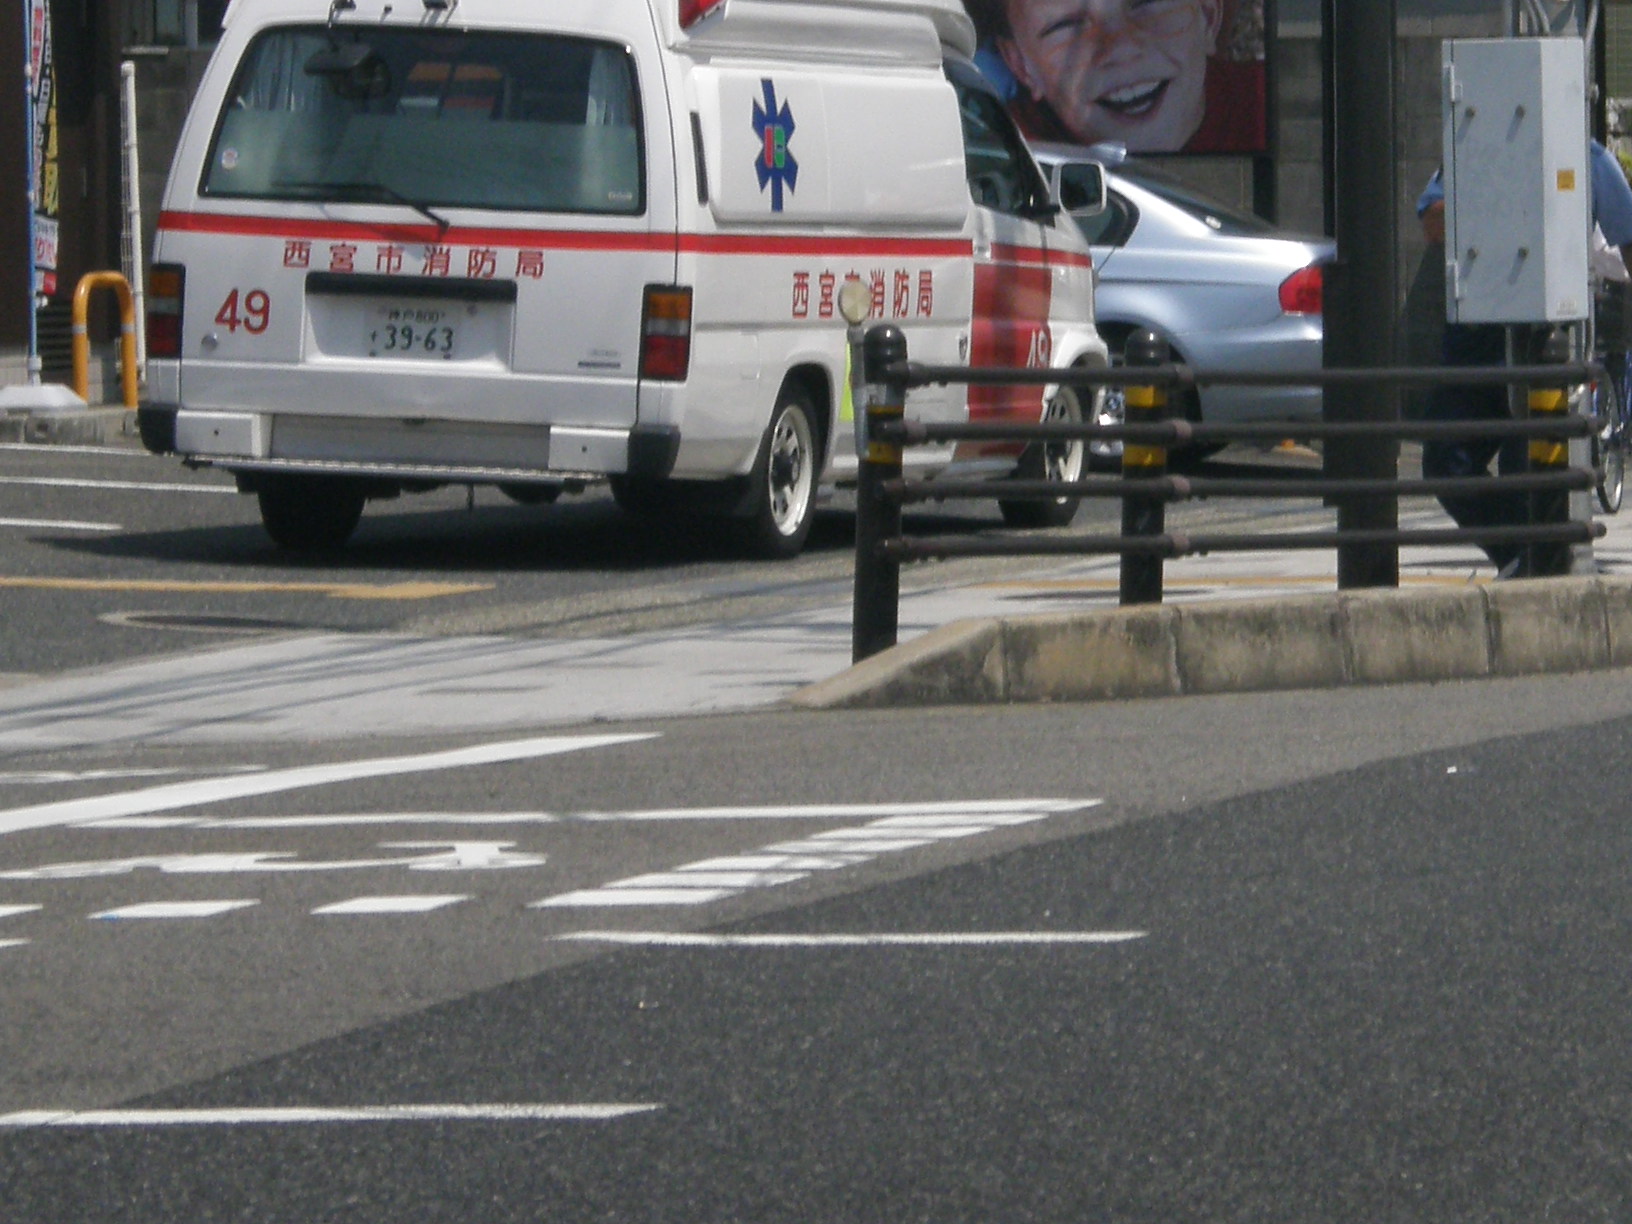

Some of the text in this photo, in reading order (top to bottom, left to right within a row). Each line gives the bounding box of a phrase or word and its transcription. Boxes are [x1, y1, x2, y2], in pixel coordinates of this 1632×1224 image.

[283, 239, 544, 280] 西宮市消防局
[214, 288, 271, 336] 49
[792, 268, 933, 319] 西宮消防局
